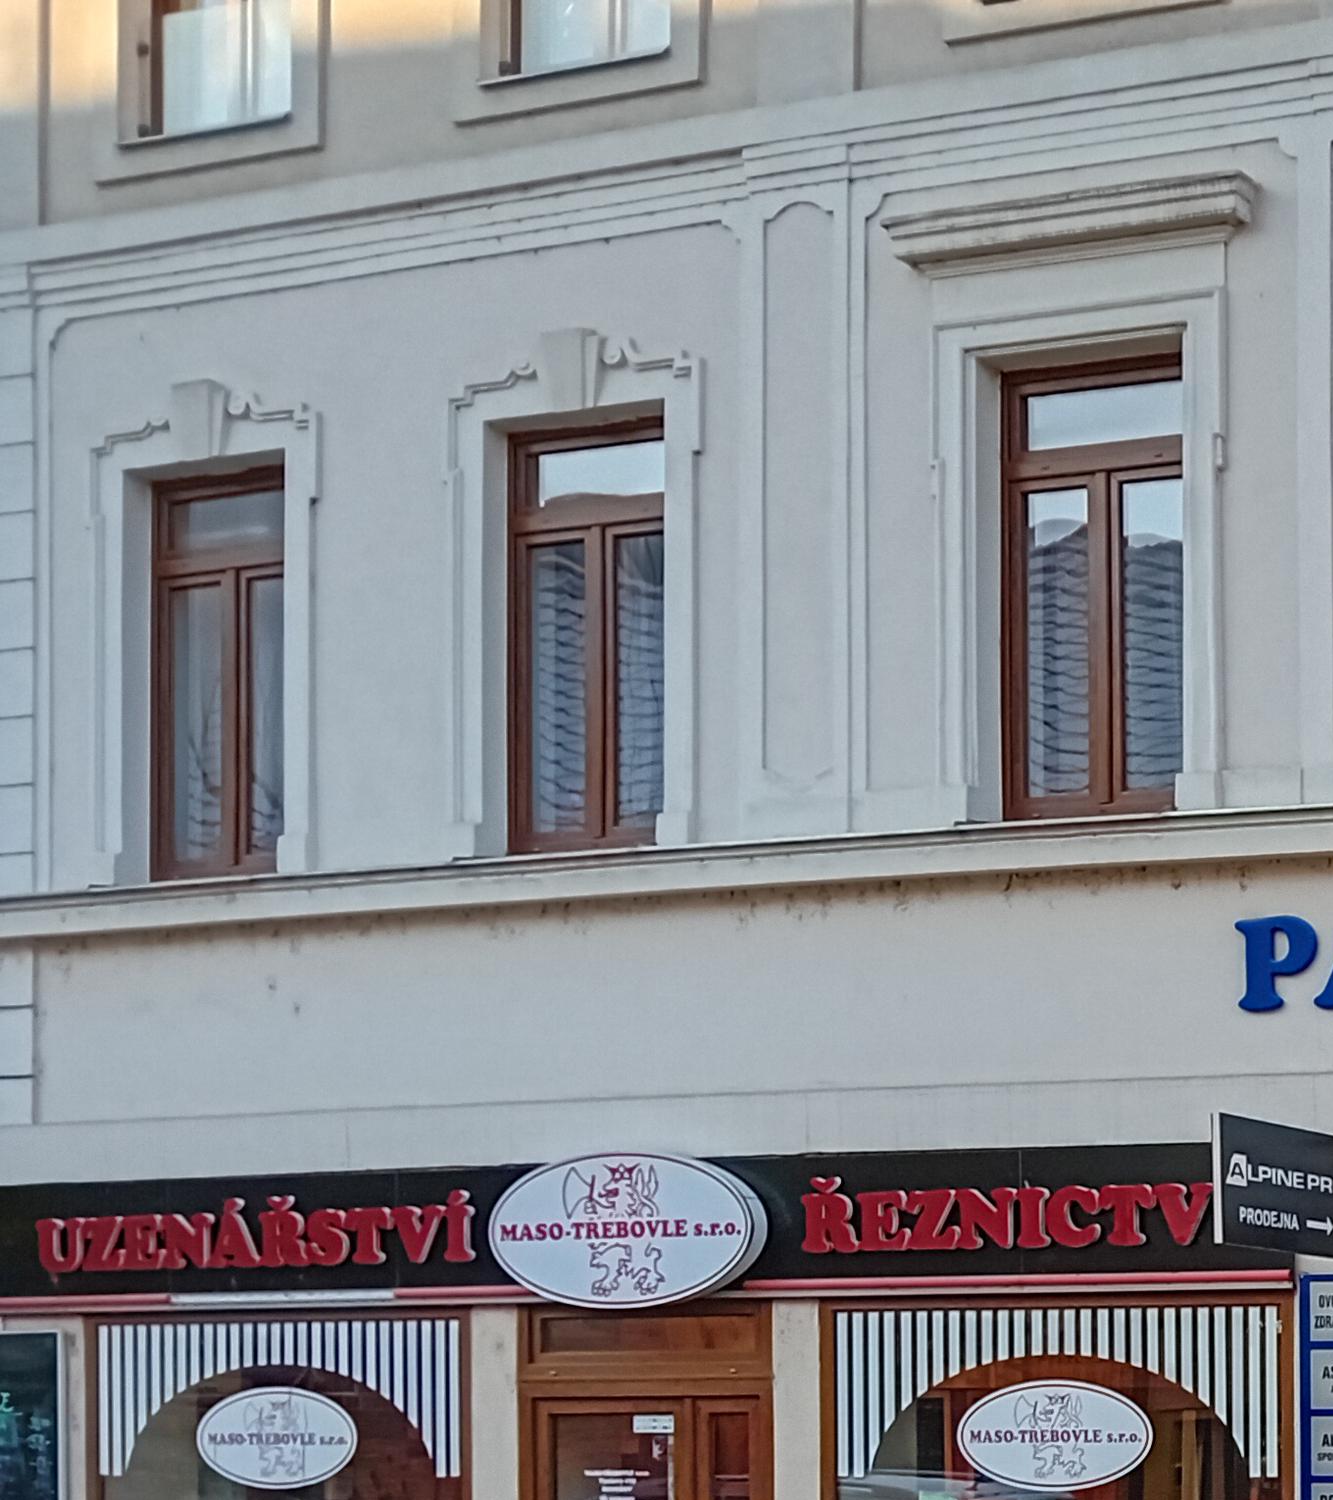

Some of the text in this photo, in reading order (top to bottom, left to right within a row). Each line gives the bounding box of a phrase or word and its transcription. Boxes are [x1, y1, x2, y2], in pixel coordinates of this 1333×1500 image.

[1225, 1152, 1305, 1190] ALPINE
[35, 1188, 476, 1274] UZENÁŘSTVÍ
[693, 1222, 742, 1237] s.r.o.
[801, 1176, 1213, 1254] ŘEZNICTV
[1239, 1205, 1300, 1231] PRODEJNA
[1107, 1431, 1143, 1444] s.r.o.
